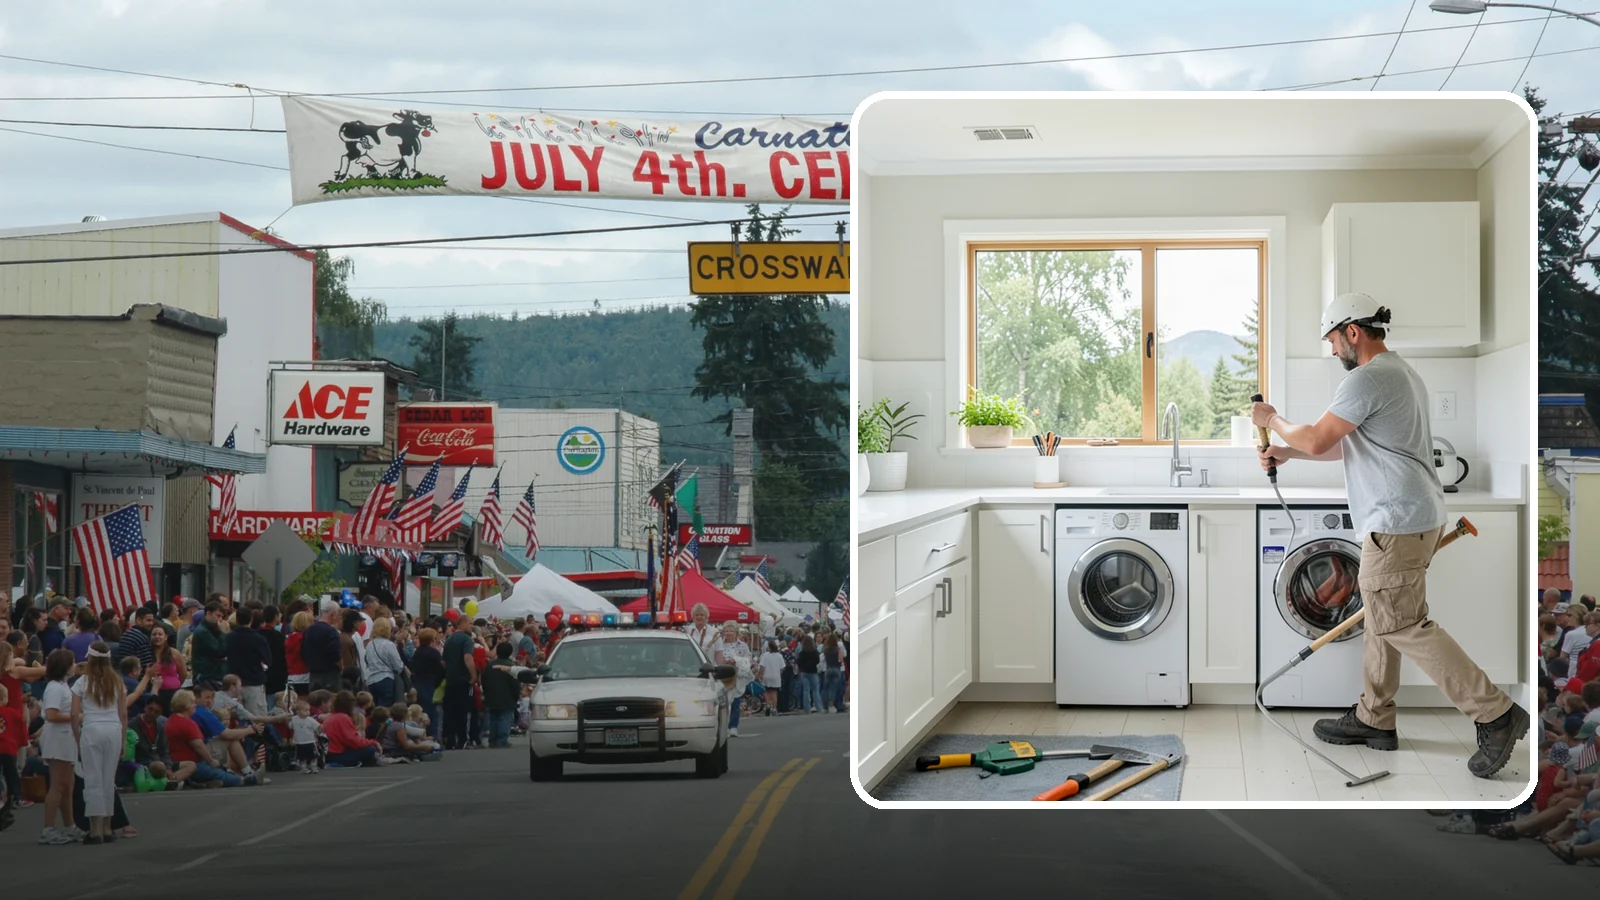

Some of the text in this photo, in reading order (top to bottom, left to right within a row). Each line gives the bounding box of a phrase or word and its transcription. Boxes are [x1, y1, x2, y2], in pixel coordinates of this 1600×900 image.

[481, 141, 605, 192] JULY
[632, 150, 746, 197] 4th.
[697, 254, 850, 280] CROSSWA
[283, 380, 373, 420] ACE
[406, 409, 485, 421] CEDAR LOG
[283, 421, 371, 436] Hardware
[354, 467, 386, 480] Simpl
[95, 485, 124, 494] Vincent
[126, 485, 135, 494] de
[138, 486, 155, 495] Paul
[688, 526, 741, 535] CRNATION
[699, 535, 730, 543] GLASS
